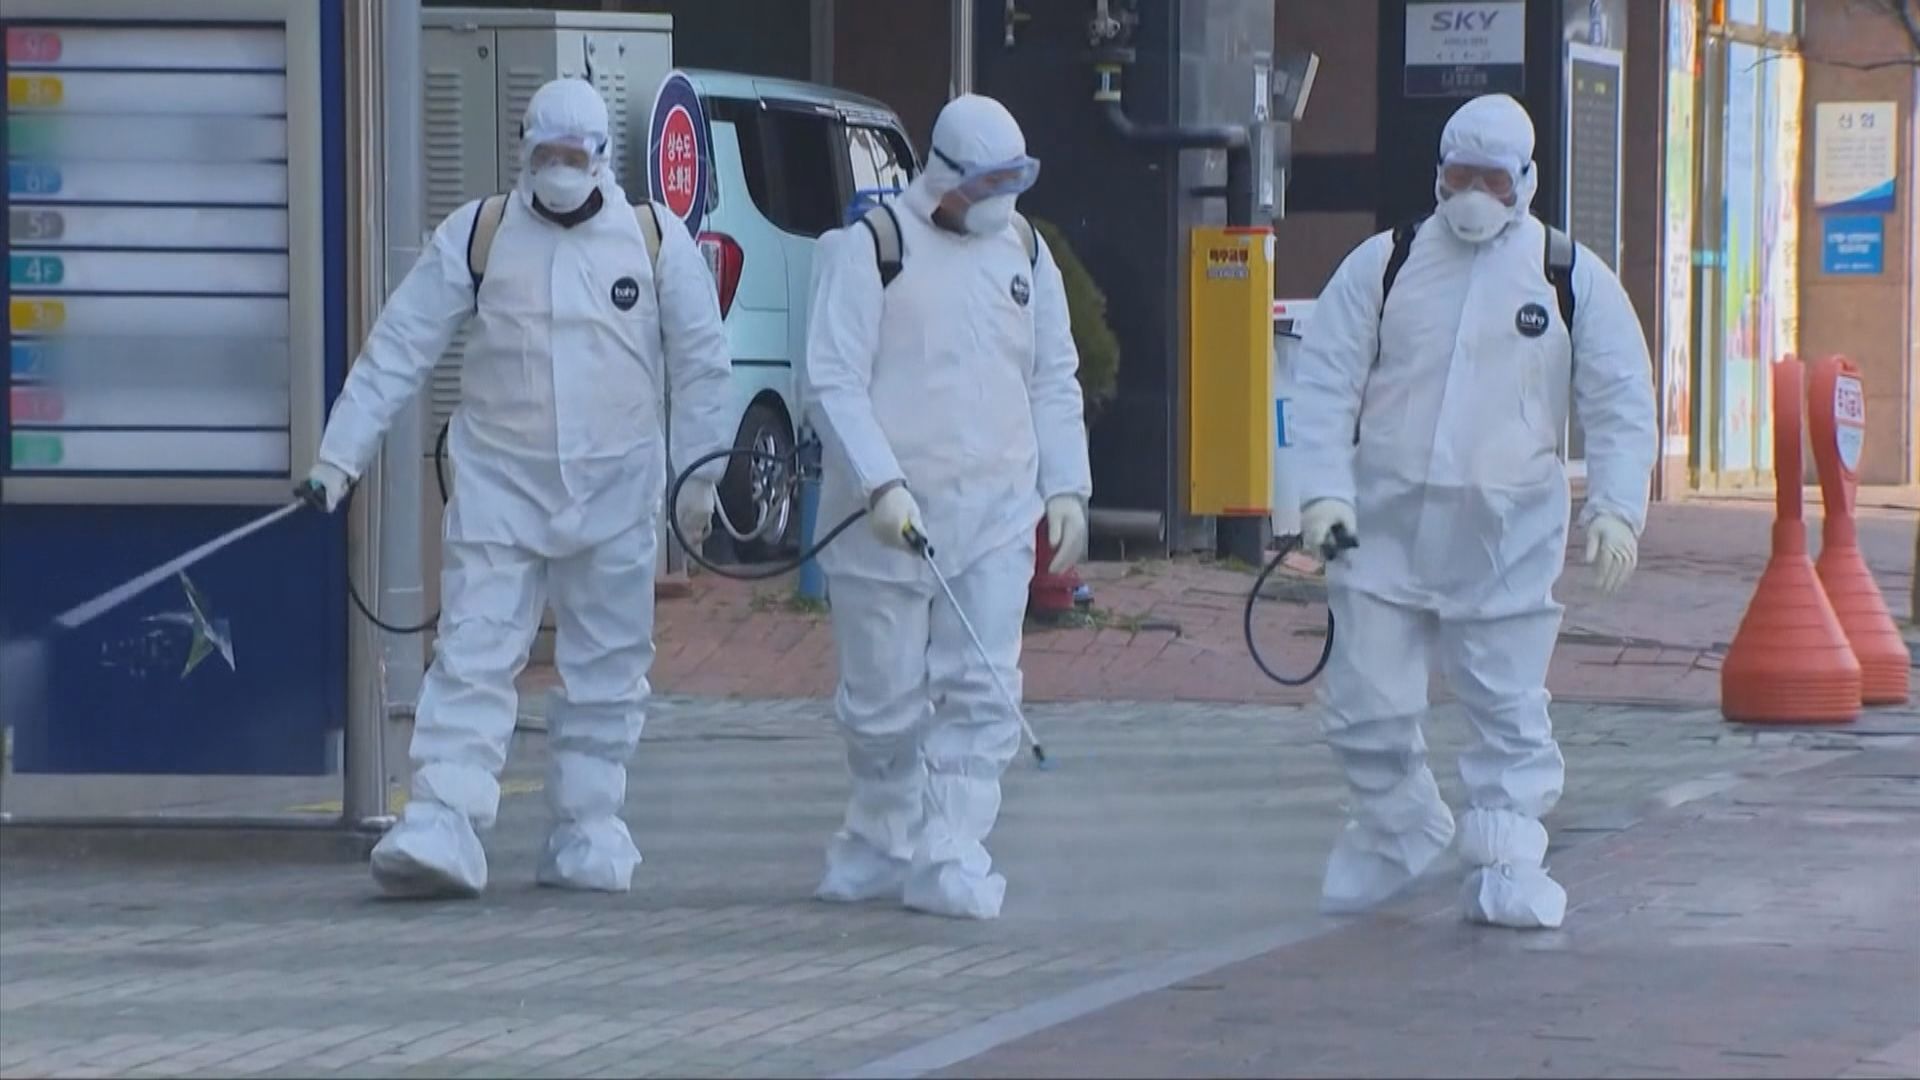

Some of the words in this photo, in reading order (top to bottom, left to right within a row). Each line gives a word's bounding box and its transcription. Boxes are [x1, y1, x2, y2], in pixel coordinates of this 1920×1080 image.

[1431, 10, 1498, 31] SKY
[667, 133, 691, 162] 상수도
[668, 165, 691, 195] 소화전
[26, 258, 53, 282] 4F
